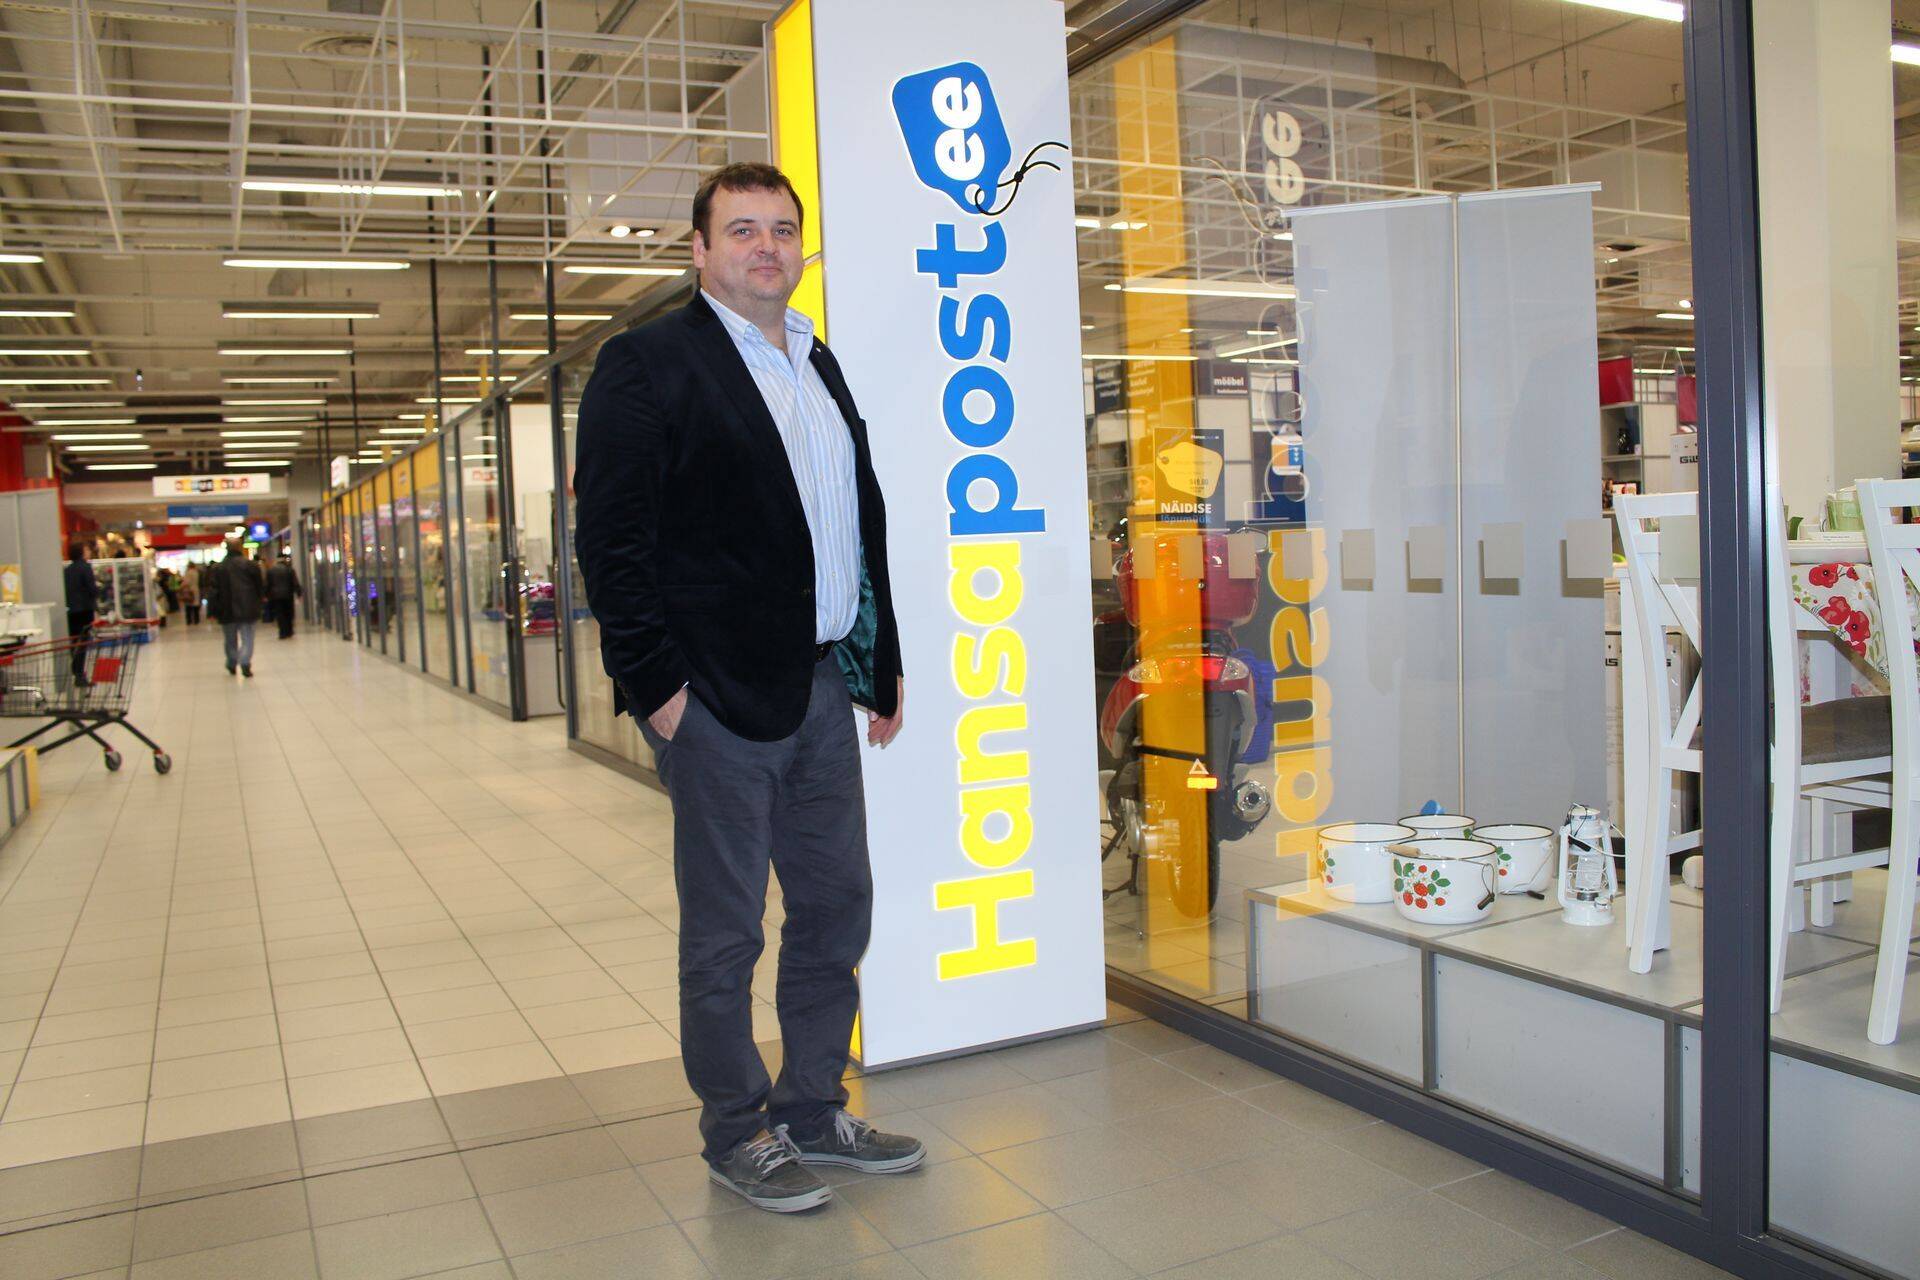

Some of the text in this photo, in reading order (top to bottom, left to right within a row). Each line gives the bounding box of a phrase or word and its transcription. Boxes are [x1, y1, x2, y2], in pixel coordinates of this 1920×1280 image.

[916, 76, 1047, 982] Hansapost ee
[1160, 500, 1212, 514] NÄIDISE
